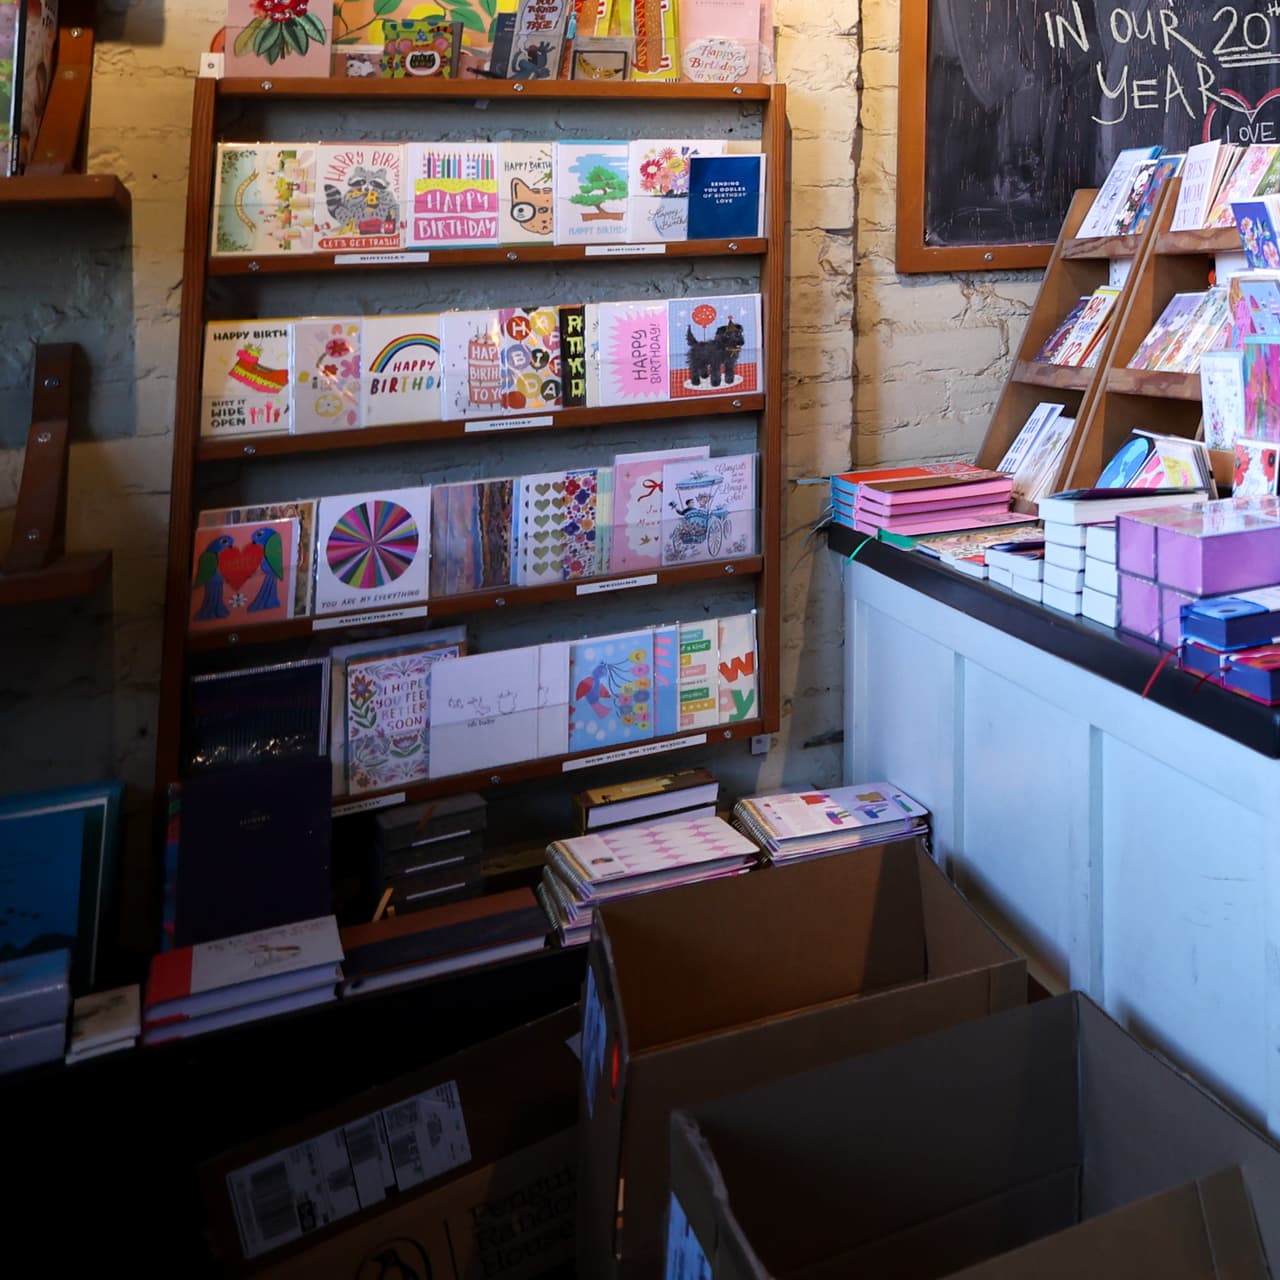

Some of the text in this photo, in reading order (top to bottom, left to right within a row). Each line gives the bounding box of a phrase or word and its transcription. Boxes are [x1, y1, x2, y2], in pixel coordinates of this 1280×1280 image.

[1045, 4, 1205, 60] IN OUR
[1092, 60, 1240, 126] YEAR
[1226, 122, 1278, 148] LOVE
[324, 149, 365, 183] HAPPY
[504, 160, 527, 171] HAPPY
[426, 189, 489, 213] HAPPY
[715, 197, 734, 205] LOVE
[418, 219, 497, 239] BIRTHDAY
[213, 330, 250, 341] HAPPY
[392, 359, 436, 373] HAPPY
[211, 406, 246, 419] WIDE
[210, 416, 247, 429] OPEN
[320, 598, 340, 610] YOU
[373, 588, 421, 603] EVERYTHING
[386, 715, 424, 732] SOON
